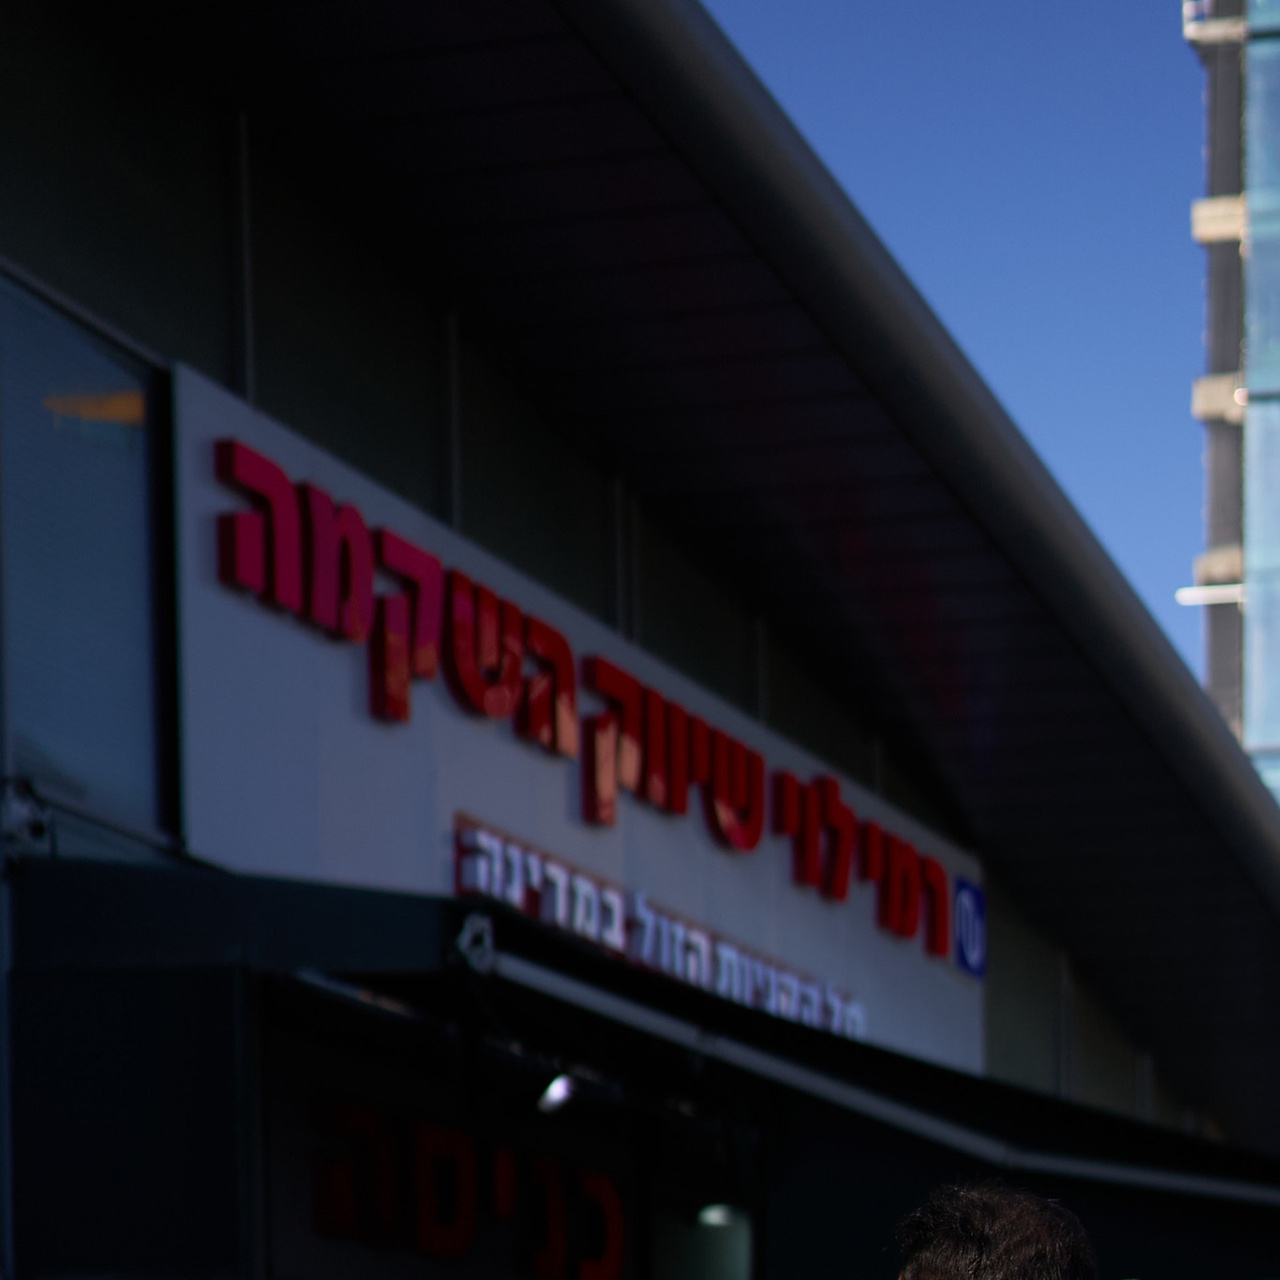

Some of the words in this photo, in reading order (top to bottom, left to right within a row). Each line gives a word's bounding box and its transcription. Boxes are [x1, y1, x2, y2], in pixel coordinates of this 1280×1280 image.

[215, 438, 578, 758] השקמה
[582, 656, 764, 853] שיווק
[473, 829, 628, 954] במדינה
[772, 770, 858, 901] לוי
[859, 818, 947, 958] רמי
[634, 892, 712, 989] הזול
